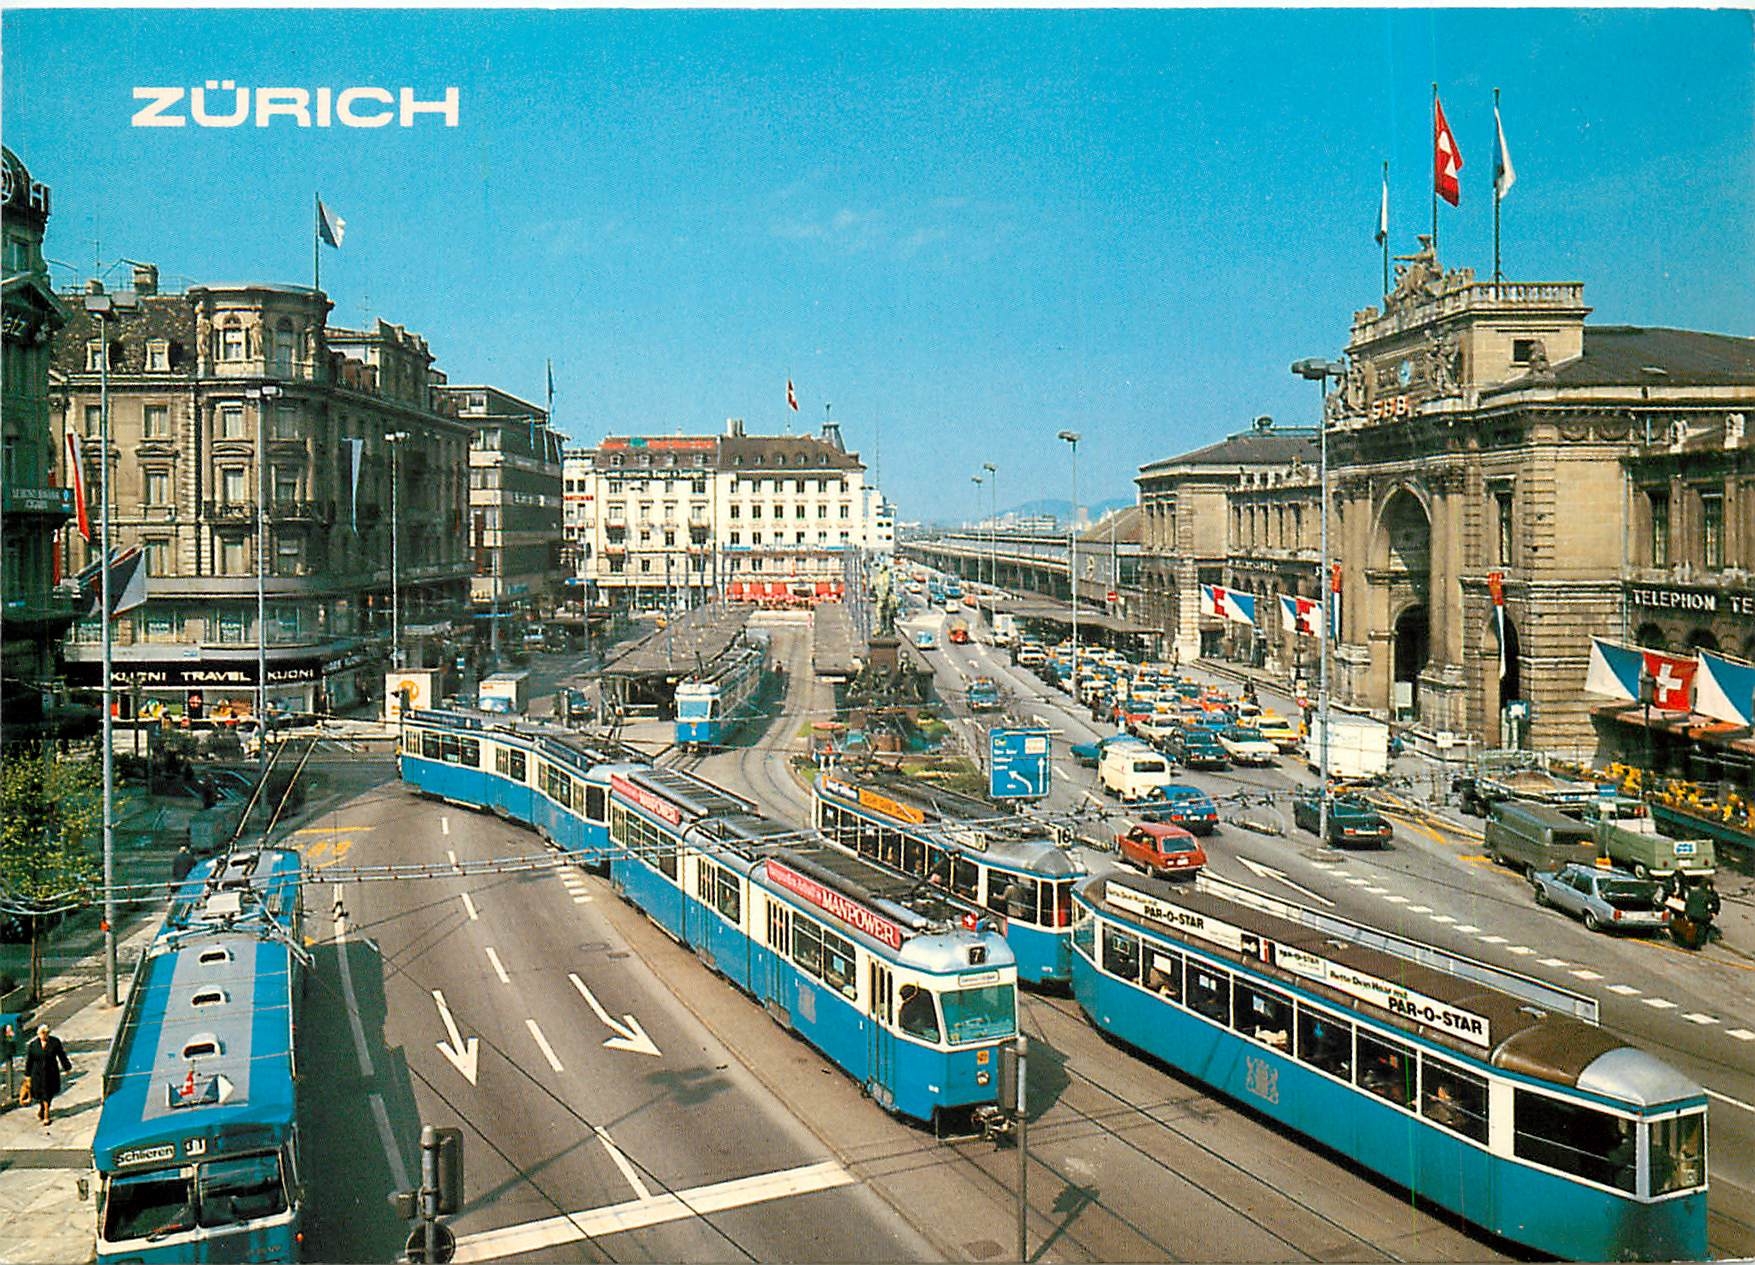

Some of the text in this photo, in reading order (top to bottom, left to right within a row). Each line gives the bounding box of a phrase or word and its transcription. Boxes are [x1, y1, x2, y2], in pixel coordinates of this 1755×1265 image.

[1632, 589, 1716, 611] TELEPHON
[180, 671, 251, 681] TRAVEL
[267, 669, 314, 681] KUONI
[821, 889, 897, 947] MANPOWER
[1144, 905, 1204, 930] PAR-O-STAR
[971, 948, 981, 962] 7
[1388, 996, 1483, 1036] PAR-O-STAR
